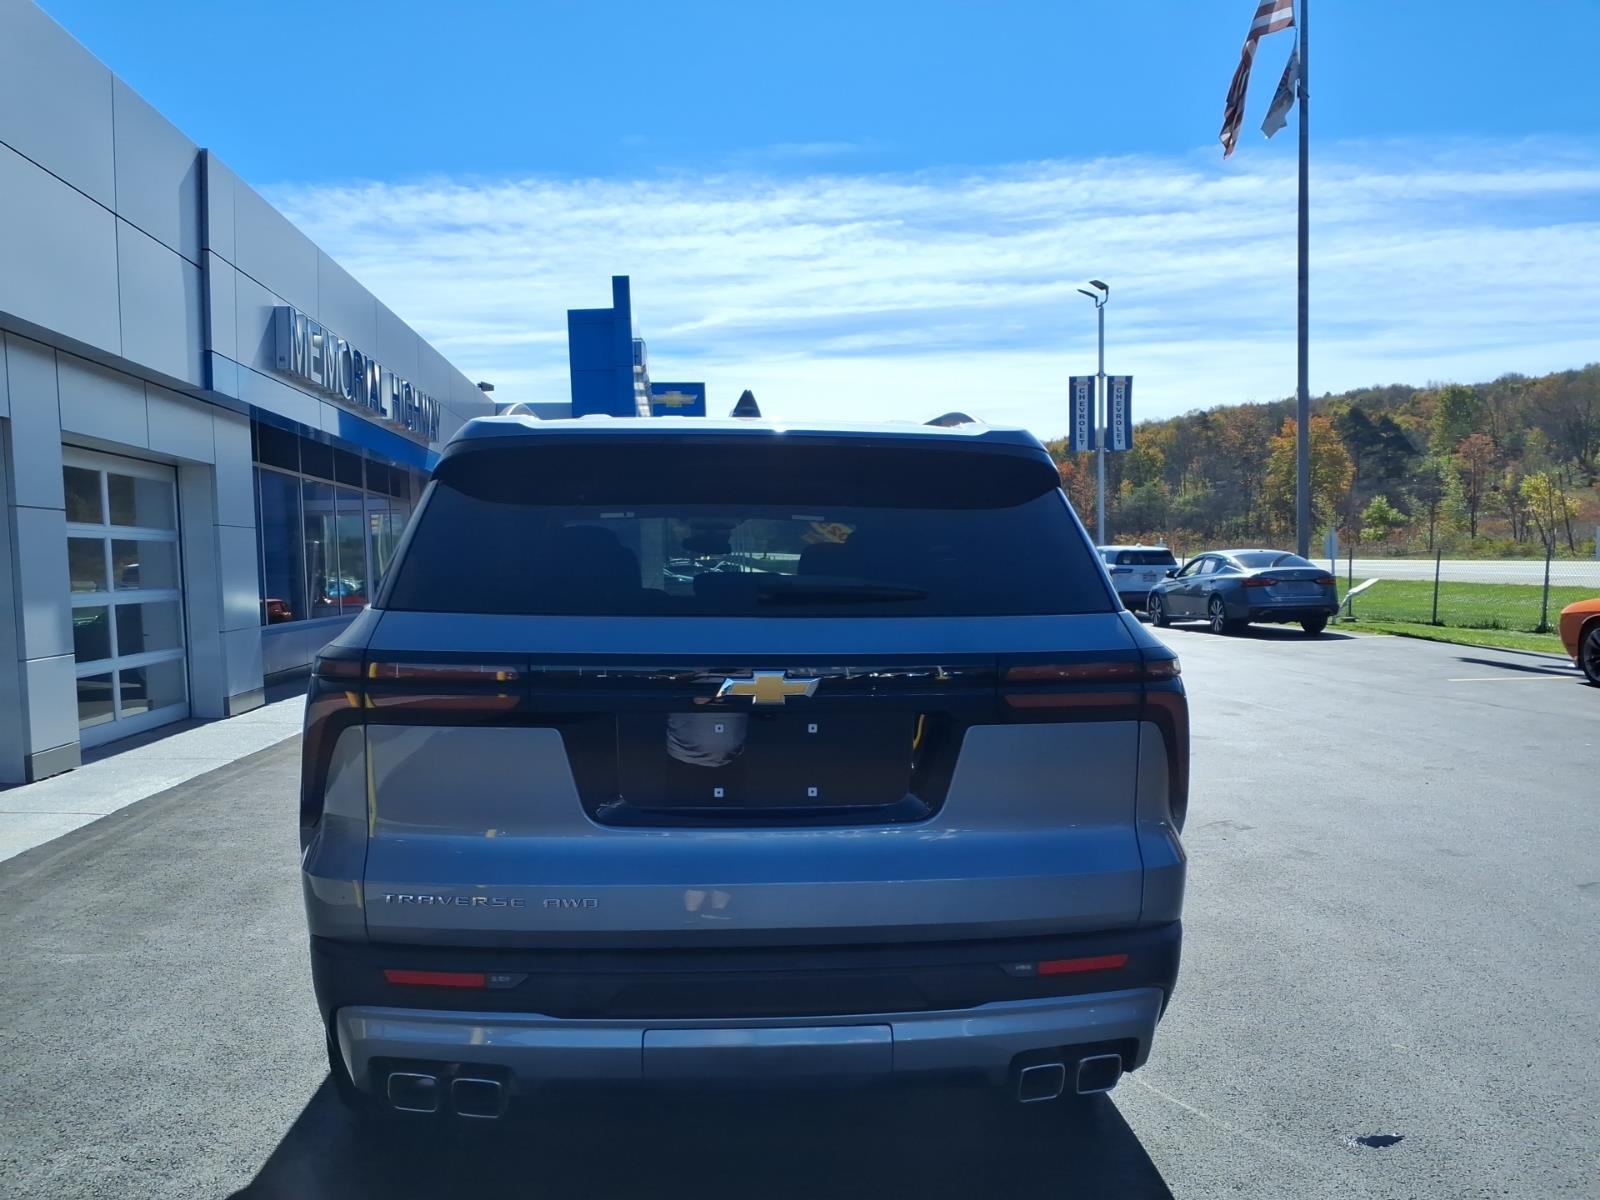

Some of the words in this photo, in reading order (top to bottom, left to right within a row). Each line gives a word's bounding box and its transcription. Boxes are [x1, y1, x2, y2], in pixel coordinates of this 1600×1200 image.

[287, 306, 394, 421] MEMORIAL
[1078, 387, 1086, 446] CHEVROLET
[381, 894, 525, 908] TRAVERSE
[542, 898, 599, 909] AWD
